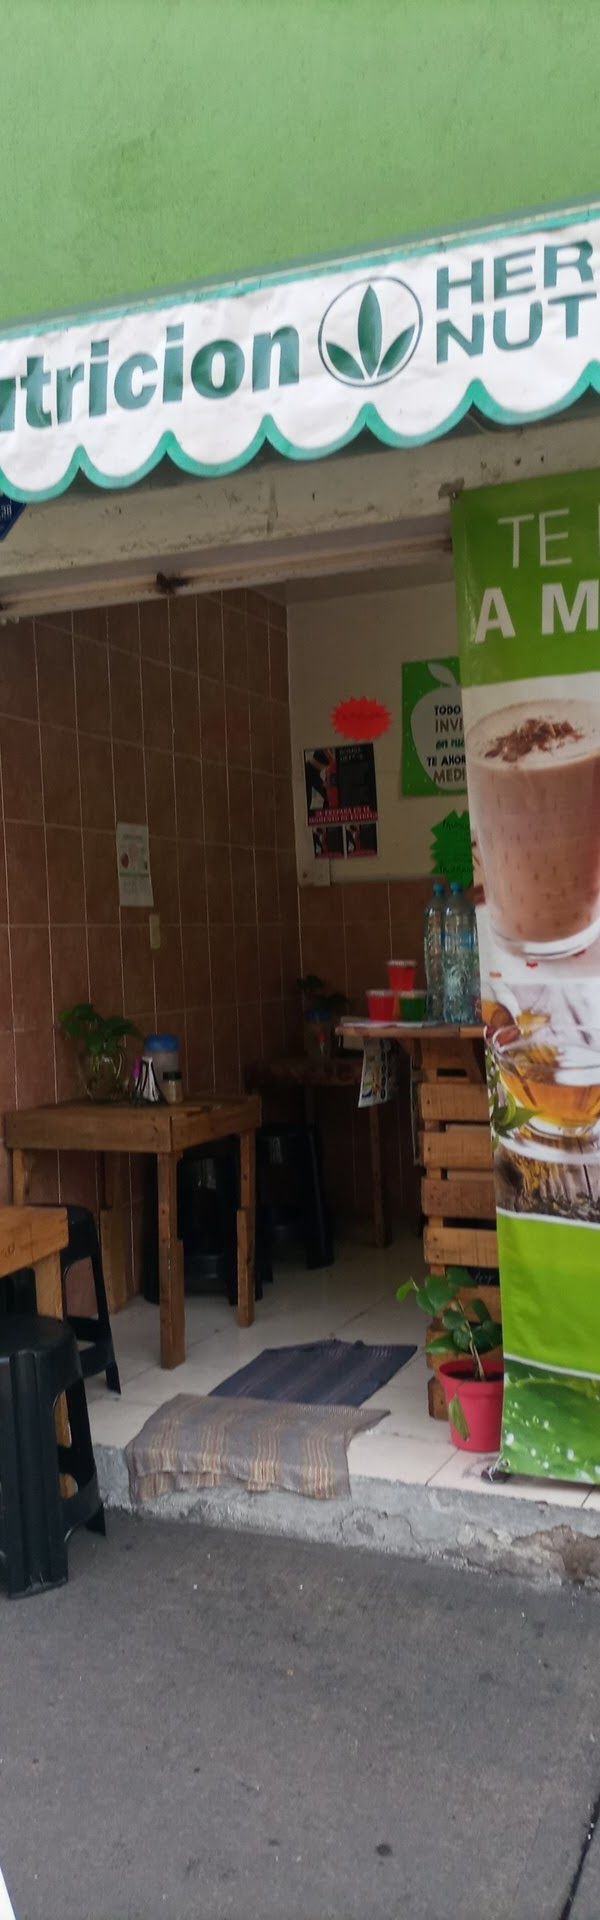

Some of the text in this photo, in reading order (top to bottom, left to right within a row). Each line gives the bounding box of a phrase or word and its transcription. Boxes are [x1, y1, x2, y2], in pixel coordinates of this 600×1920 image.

[436, 239, 594, 311] HER
[436, 292, 597, 365] NUT
[498, 508, 573, 569] TE
[475, 579, 600, 644] A M
[434, 704, 462, 716] TODO
[433, 768, 466, 783] MEDI
